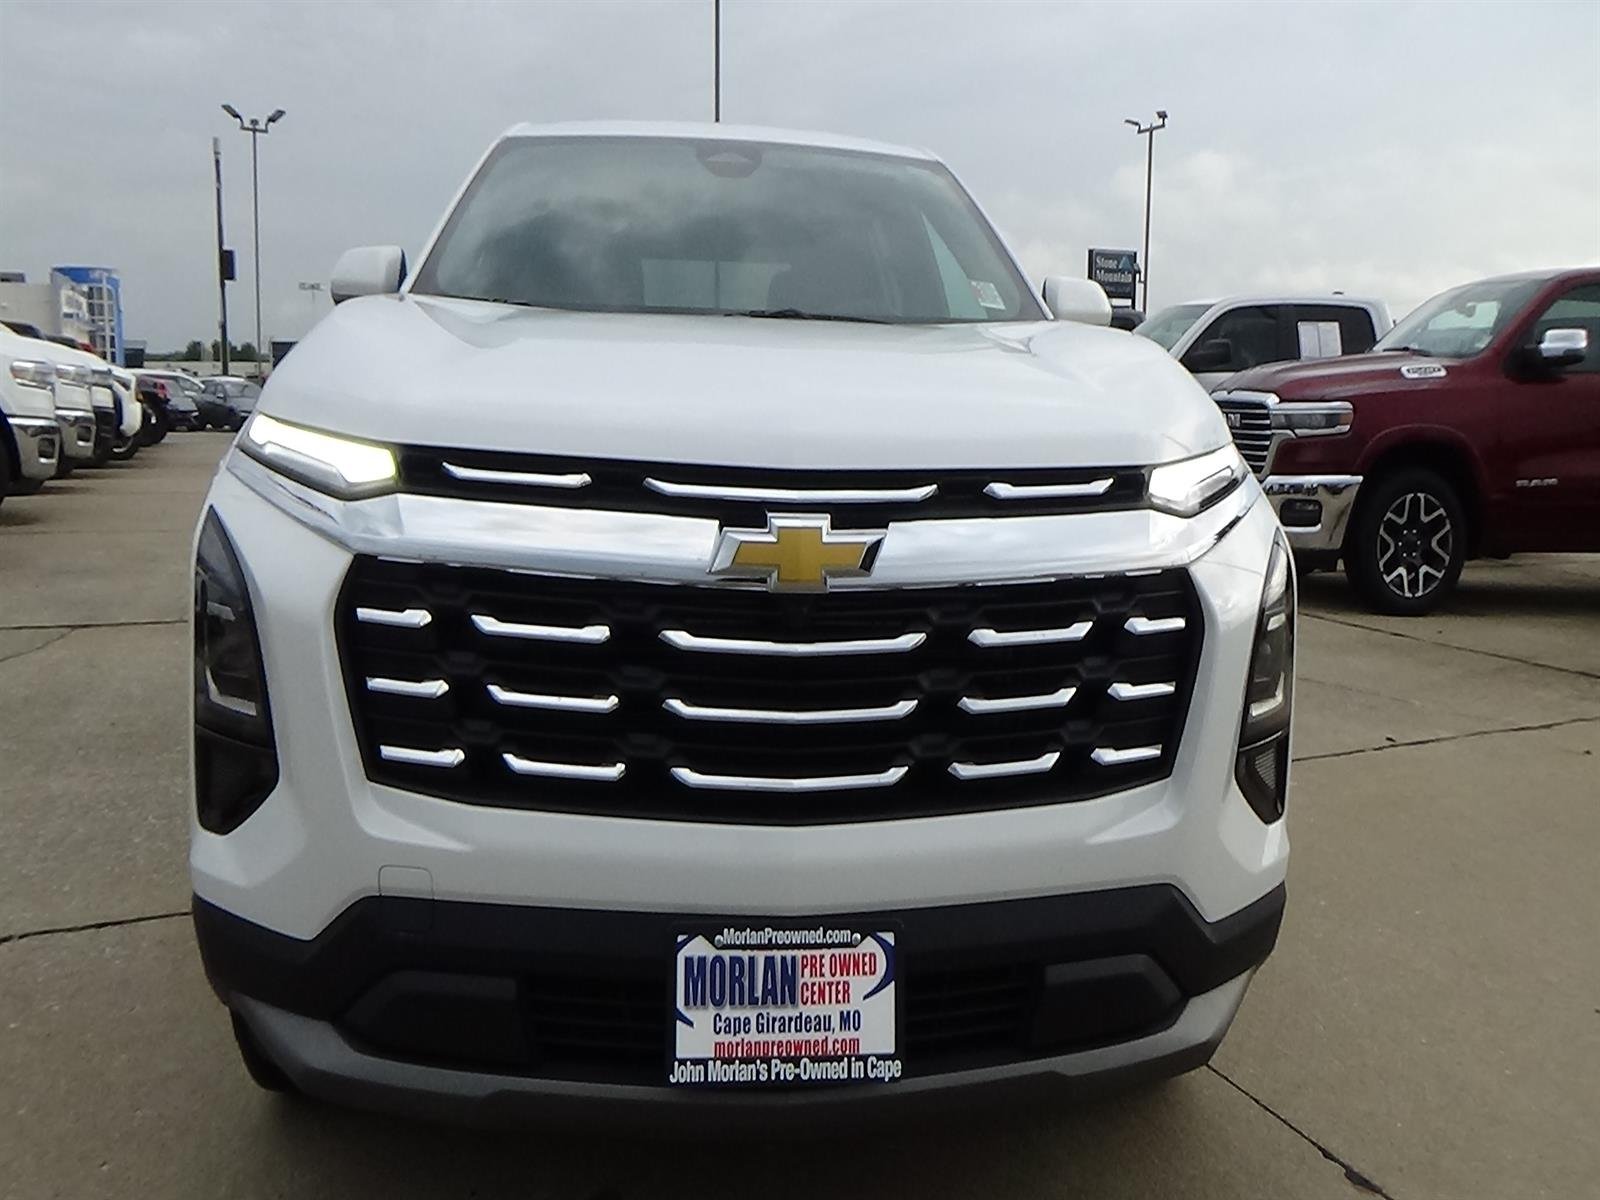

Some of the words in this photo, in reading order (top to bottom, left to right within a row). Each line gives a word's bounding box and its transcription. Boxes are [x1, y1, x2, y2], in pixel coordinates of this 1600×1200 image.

[1515, 478, 1558, 488] RAM
[723, 926, 851, 945] MorlanPreowned.com
[801, 954, 825, 978] PRE
[829, 952, 877, 978] OWNED
[684, 954, 798, 1007] MORLAN
[800, 981, 850, 1006] CENTER
[713, 1012, 751, 1037] Cape
[755, 1011, 836, 1034] Girardeau,
[839, 1009, 861, 1032] MO
[714, 1036, 860, 1058] morlanpreowned.com
[669, 1060, 705, 1083] John
[707, 1059, 768, 1082] Morlan's
[771, 1056, 848, 1081] Pre-Owned
[851, 1056, 864, 1079] in
[867, 1056, 902, 1082] Cape
